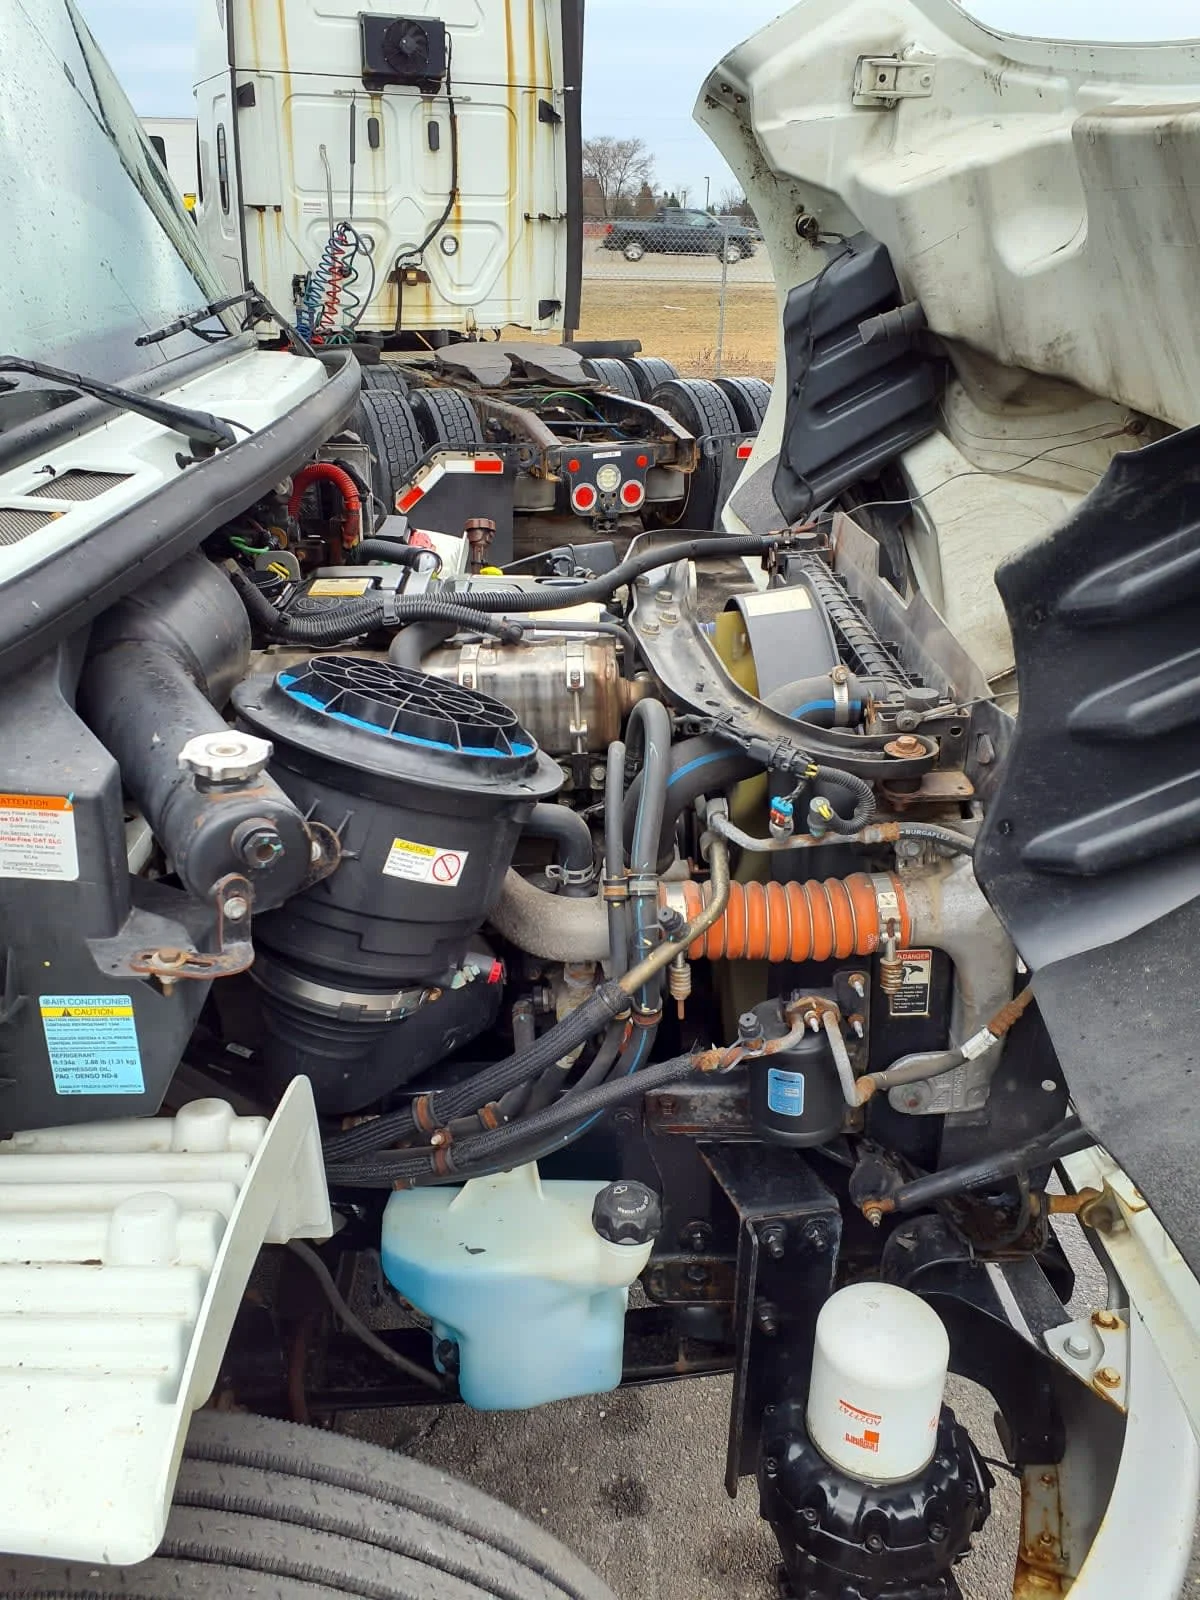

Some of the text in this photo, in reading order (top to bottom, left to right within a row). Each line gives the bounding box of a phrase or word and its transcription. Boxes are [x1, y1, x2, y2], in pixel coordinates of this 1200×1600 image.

[0, 797, 49, 807] ATTENTION
[399, 841, 431, 855] CAUTION
[51, 997, 130, 1006] AIR CONDITIONER
[73, 1008, 114, 1016] CAUTION
[125, 1058, 137, 1066] kg)
